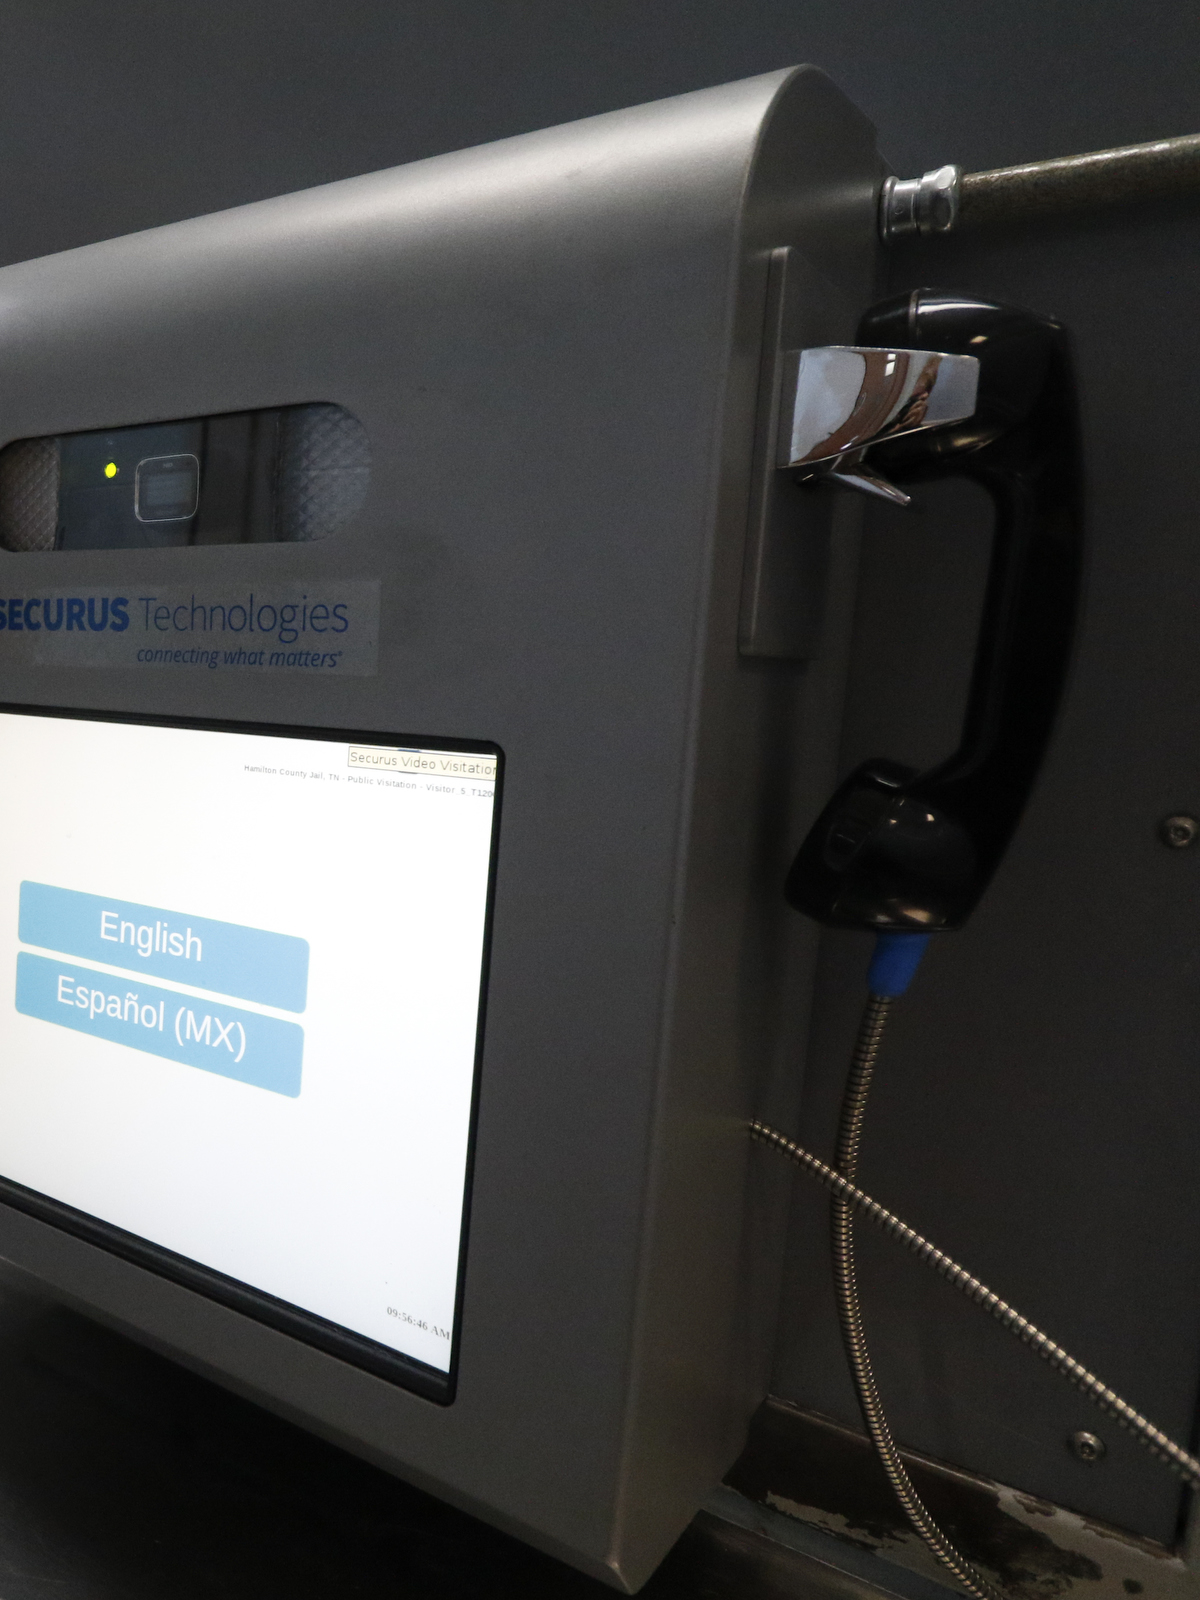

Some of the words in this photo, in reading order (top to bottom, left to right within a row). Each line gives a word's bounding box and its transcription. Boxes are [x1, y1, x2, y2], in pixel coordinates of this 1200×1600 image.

[138, 593, 349, 644] Technologies
[136, 647, 219, 669] connecting
[223, 648, 265, 667] what
[244, 764, 277, 774] Hamilton
[279, 768, 307, 779] County
[329, 773, 340, 781] TN
[347, 775, 374, 785] Public
[376, 778, 417, 789] Visitation
[350, 752, 397, 766] Securus
[401, 755, 436, 769] Video
[100, 910, 202, 961] English
[57, 975, 164, 1032] Español
[174, 1006, 247, 1063] (MX)
[386, 1306, 428, 1330] 09:56:46
[431, 1325, 450, 1340] AM
